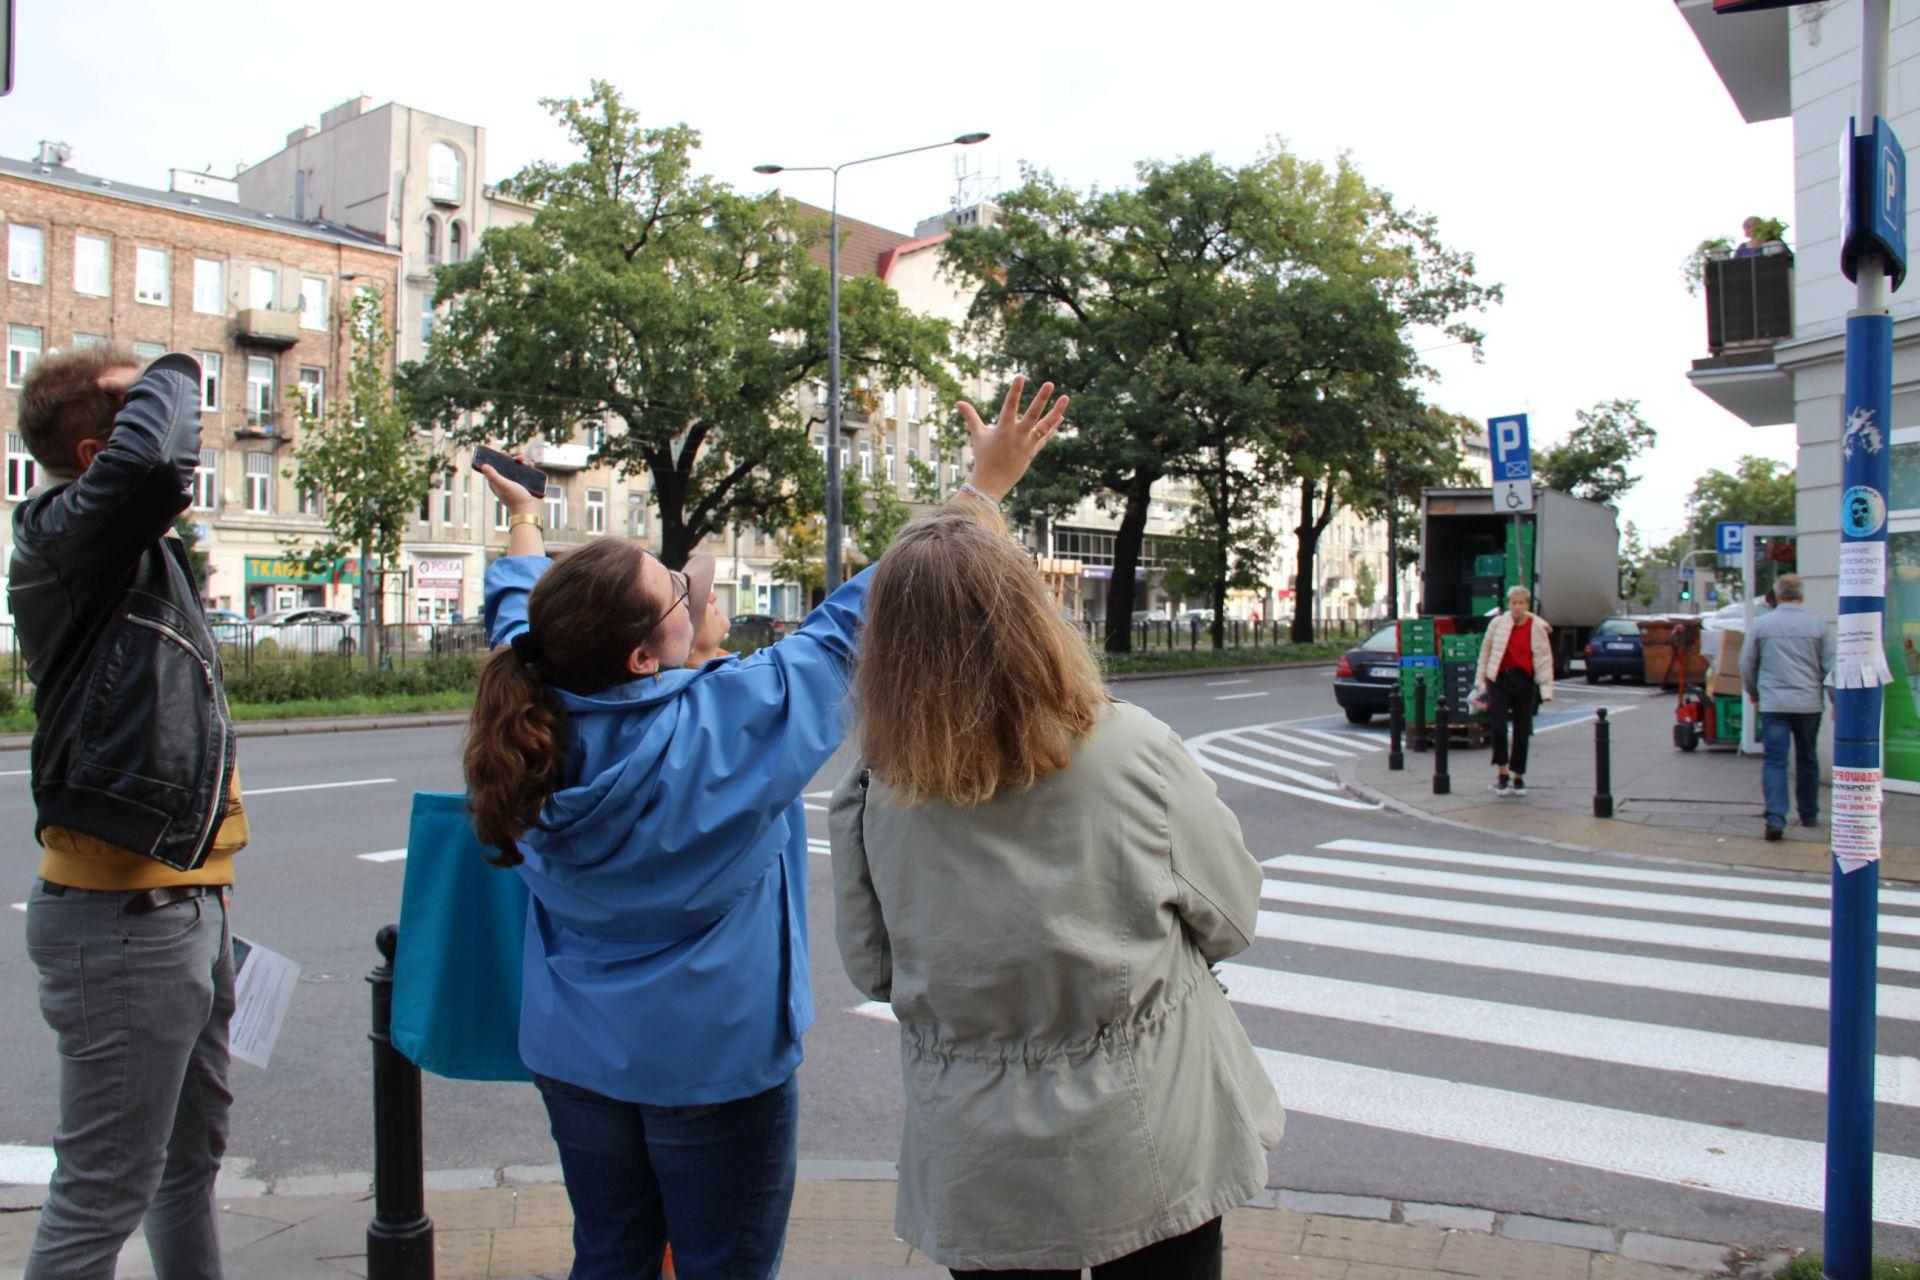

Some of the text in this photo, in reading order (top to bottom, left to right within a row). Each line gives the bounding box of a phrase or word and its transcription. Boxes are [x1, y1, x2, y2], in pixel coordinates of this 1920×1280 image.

[1887, 160, 1897, 211] P
[1496, 420, 1520, 462] P
[1723, 526, 1742, 550] P
[432, 560, 461, 571] POLKA
